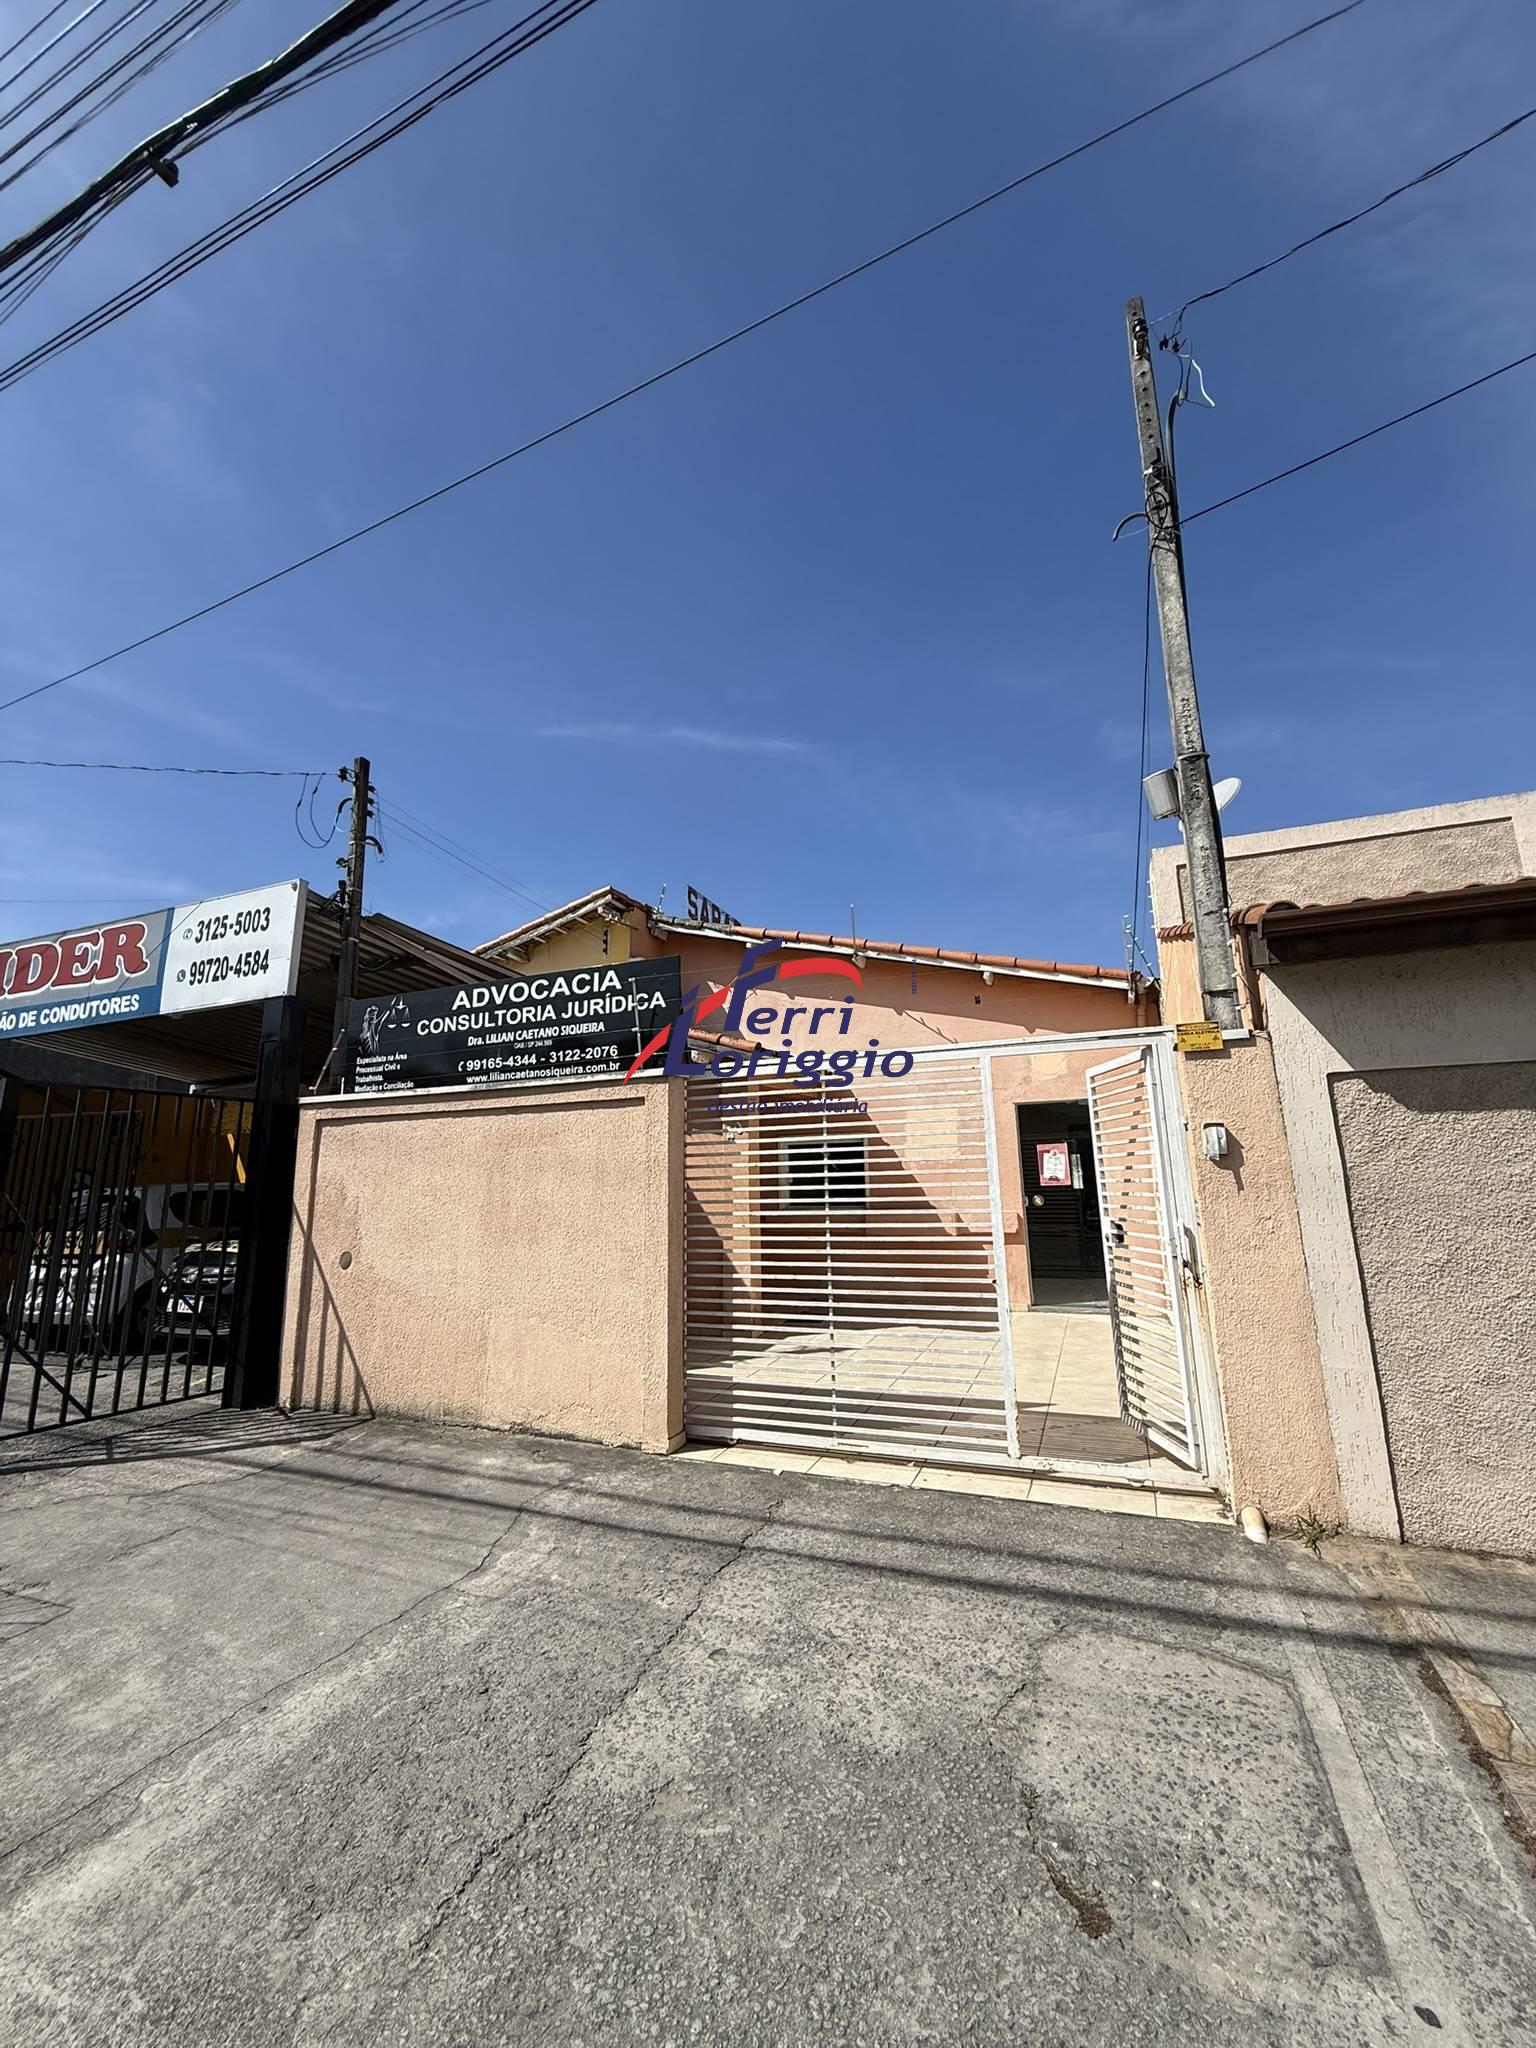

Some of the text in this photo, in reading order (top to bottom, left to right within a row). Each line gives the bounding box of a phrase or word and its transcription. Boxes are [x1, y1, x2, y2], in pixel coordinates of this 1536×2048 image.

[195, 907, 271, 944] 3125-5003
[189, 948, 270, 986] 99720-4584
[451, 969, 622, 1010] ADVOCACIA
[18, 1010, 38, 1029] DE
[40, 994, 141, 1025] CONDUTORES
[416, 991, 667, 1035] CONSULTORIA JURÍDICA
[467, 1021, 606, 1046] Dra. LILIAN CAETANO SIQUEIRA
[466, 1053, 537, 1072] 99165-4344
[549, 1045, 618, 1063] 3122-2076
[466, 1062, 620, 1083] www.liliancaetanosiqueira.com.br
